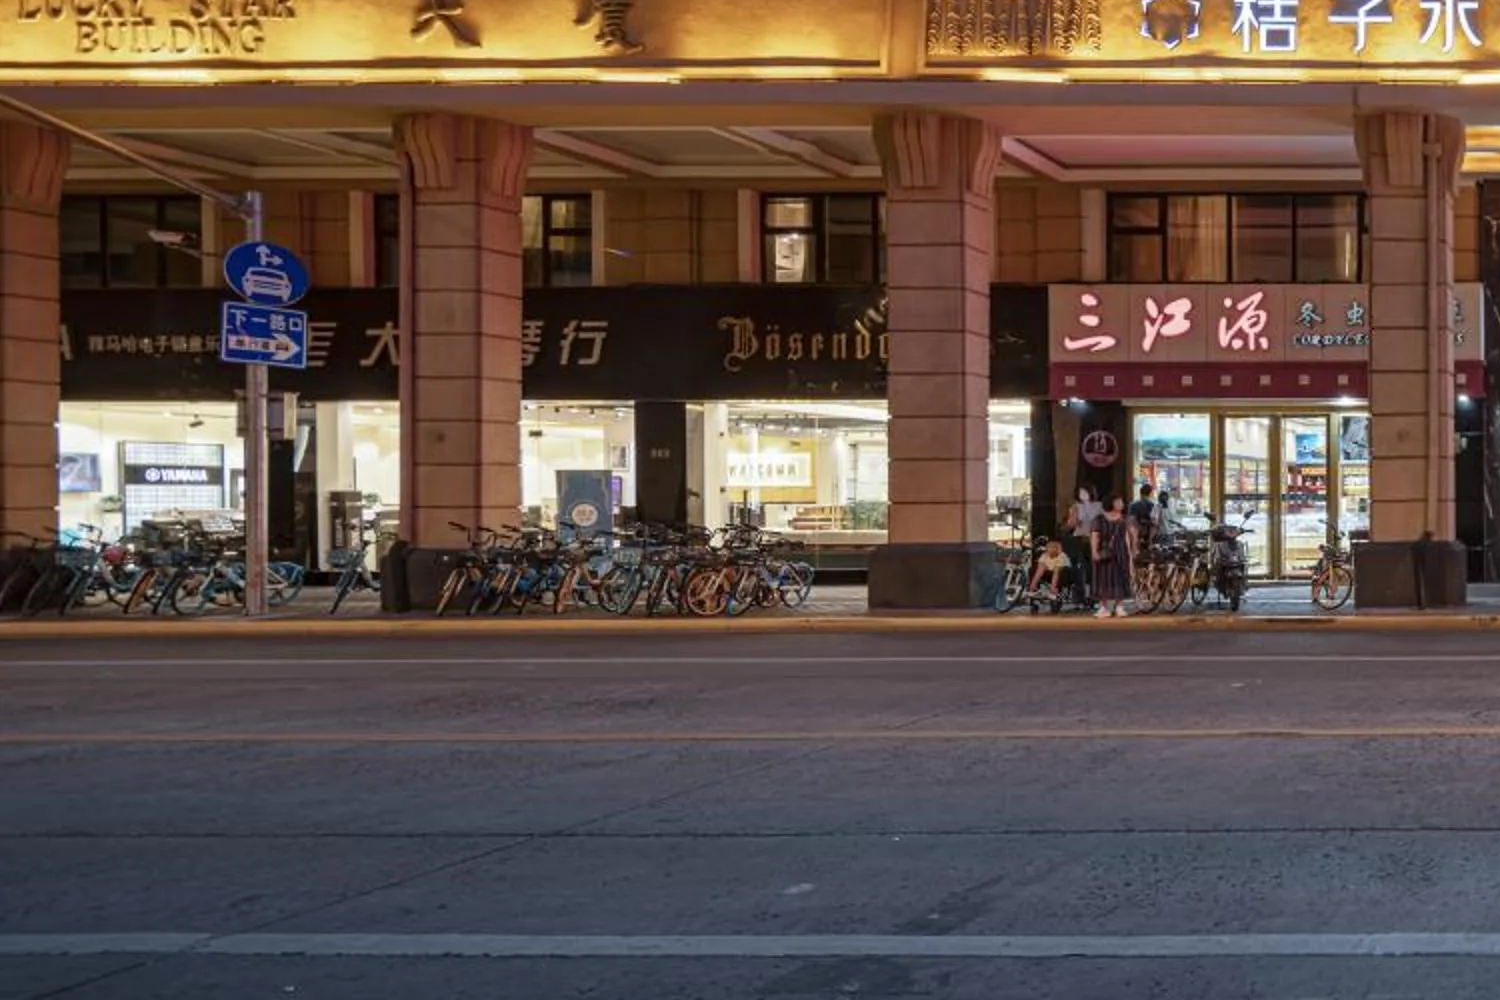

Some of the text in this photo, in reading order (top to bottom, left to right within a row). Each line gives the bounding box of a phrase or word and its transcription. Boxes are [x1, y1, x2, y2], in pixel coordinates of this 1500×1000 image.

[75, 18, 266, 55] BUILDING
[229, 308, 303, 333] 下一路口
[1063, 290, 1269, 353] 三江源
